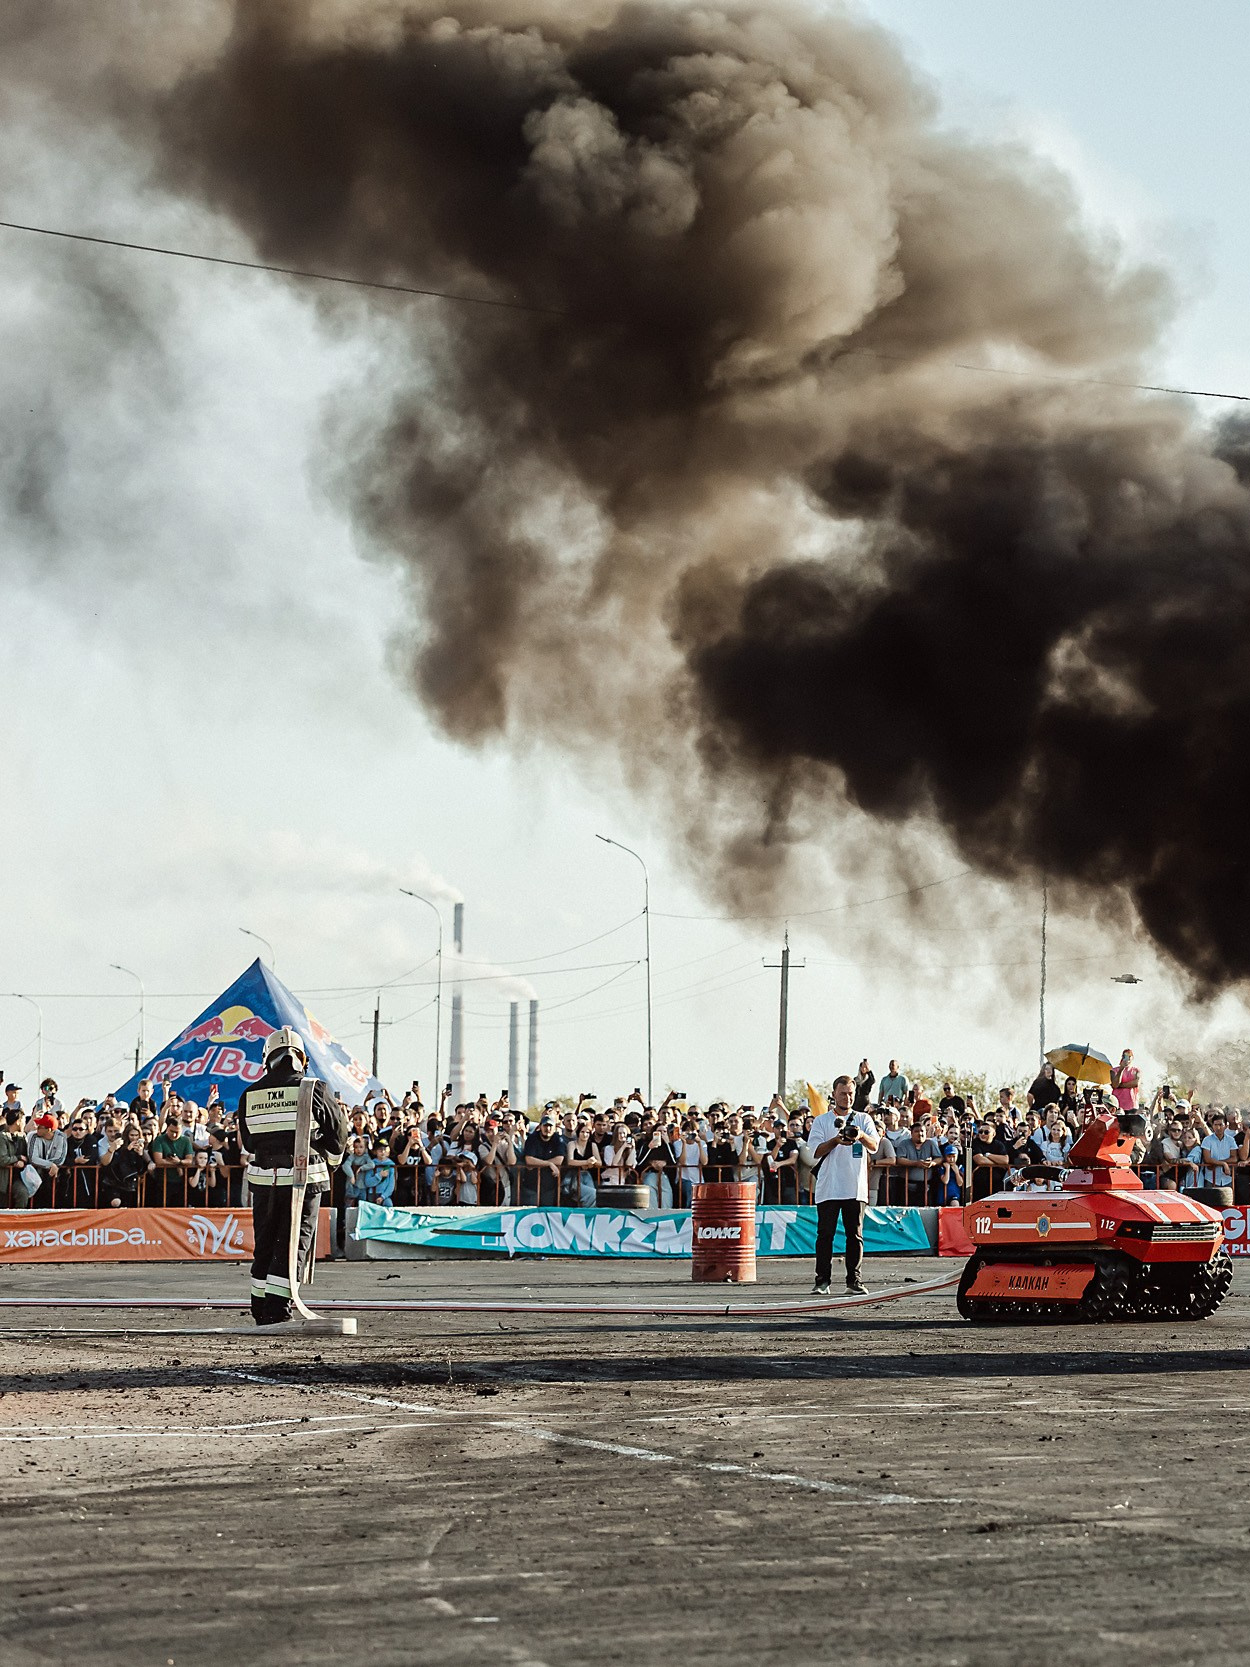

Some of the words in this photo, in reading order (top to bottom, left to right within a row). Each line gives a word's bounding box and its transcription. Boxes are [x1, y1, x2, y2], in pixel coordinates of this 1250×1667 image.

[280, 1036, 286, 1044] 1
[148, 1046, 218, 1085] Red
[209, 1047, 268, 1083] Bu
[267, 1090, 285, 1100] ТЖМ
[975, 1216, 992, 1235] 112
[1100, 1218, 1116, 1231] 112
[697, 1226, 742, 1239] LOWKZ
